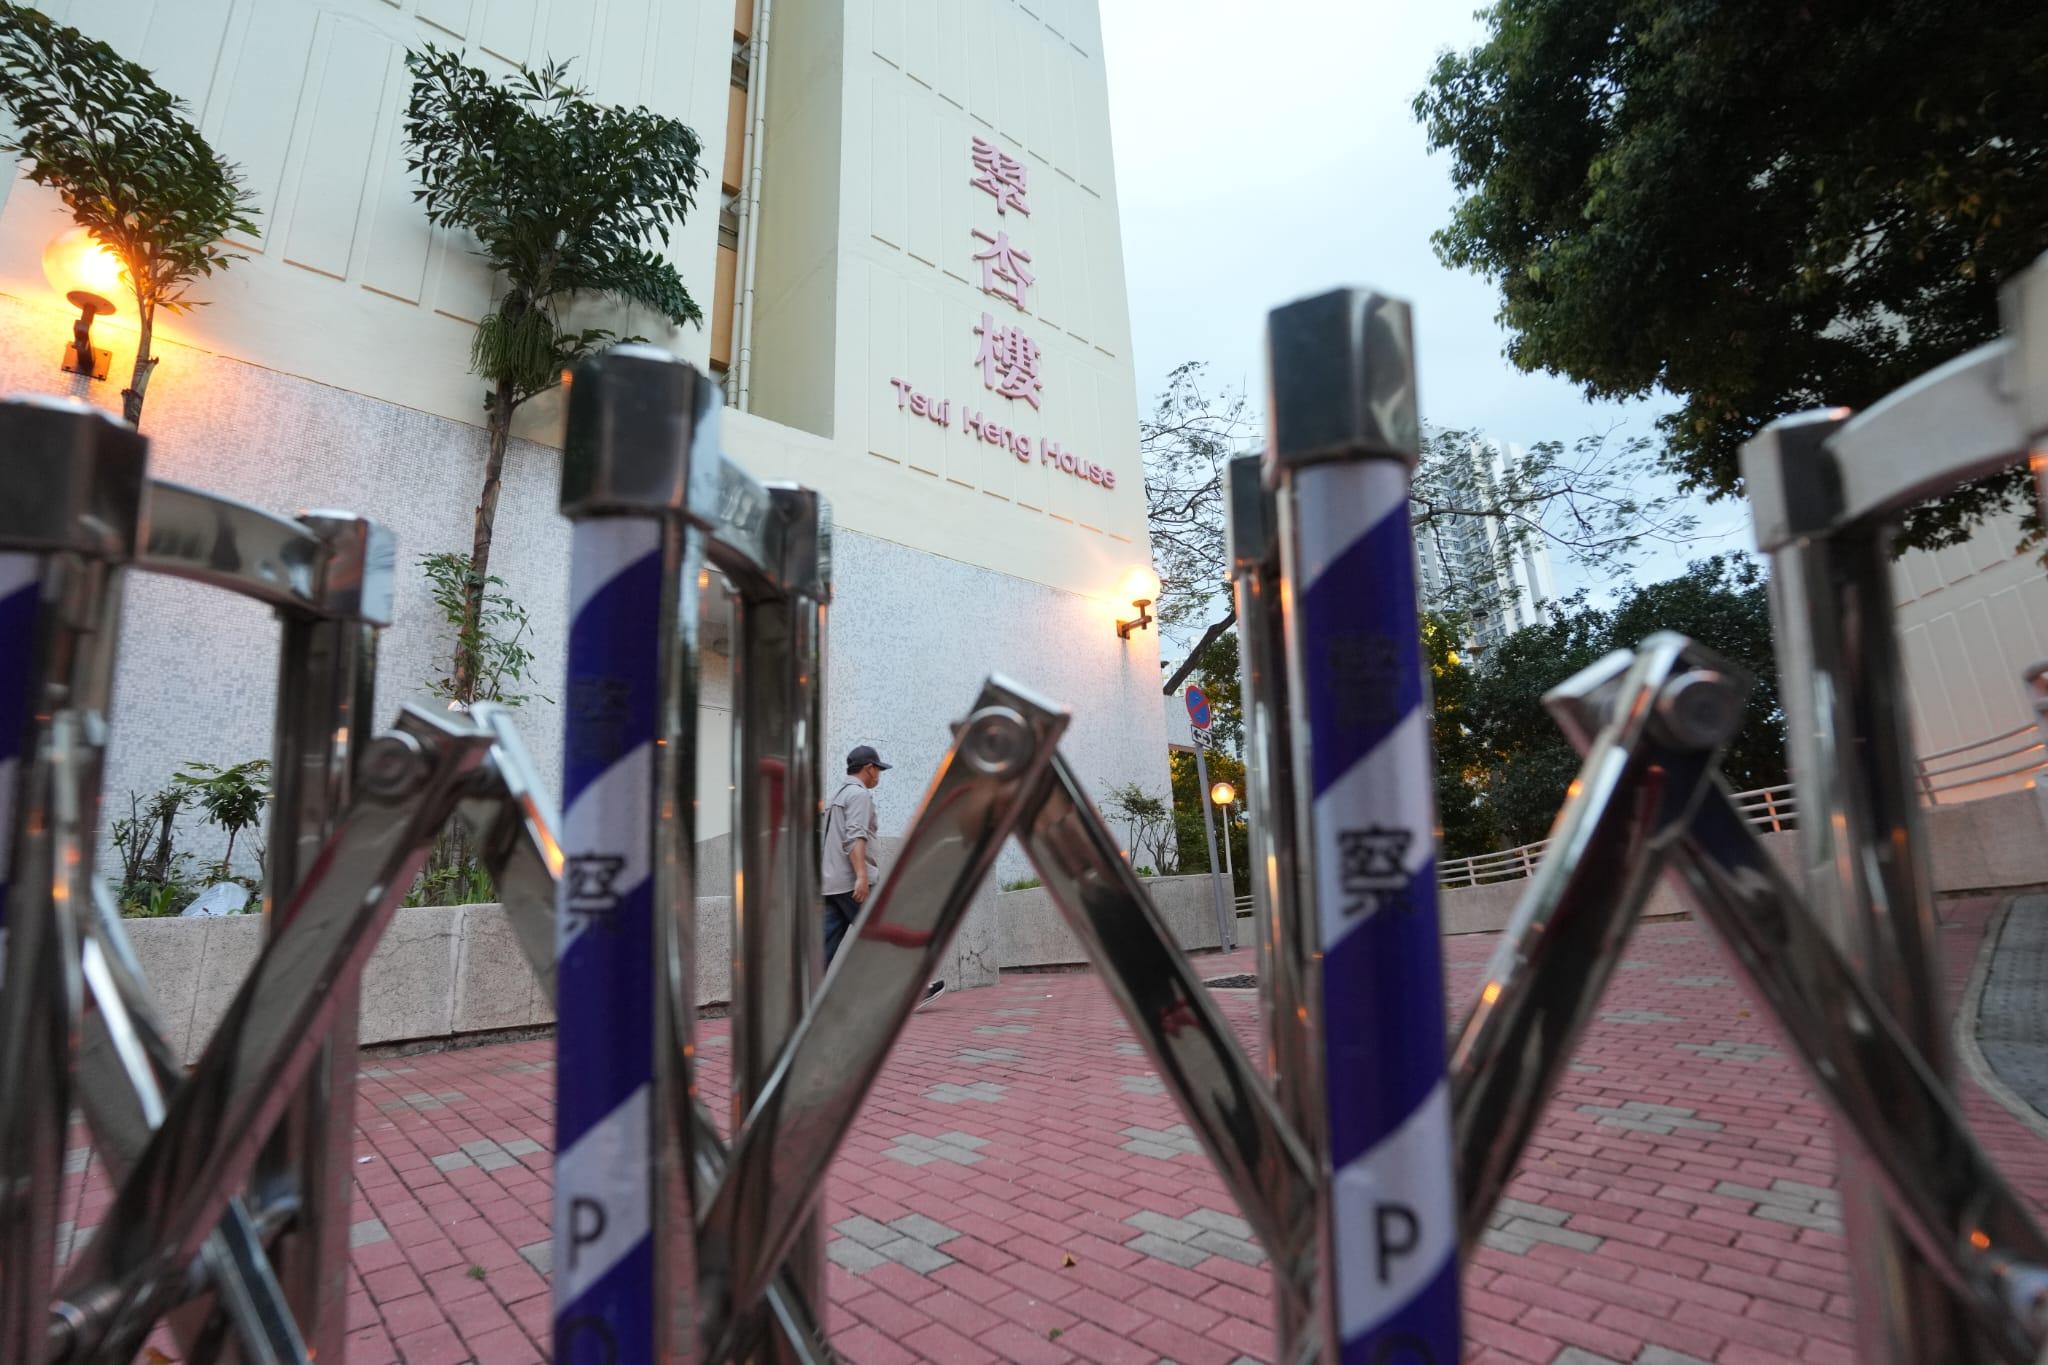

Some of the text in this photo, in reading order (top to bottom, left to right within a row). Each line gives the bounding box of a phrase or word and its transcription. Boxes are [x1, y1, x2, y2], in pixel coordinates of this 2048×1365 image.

[970, 135, 1042, 412] 翠杏樓
[890, 376, 1116, 490] Tsui Heng House
